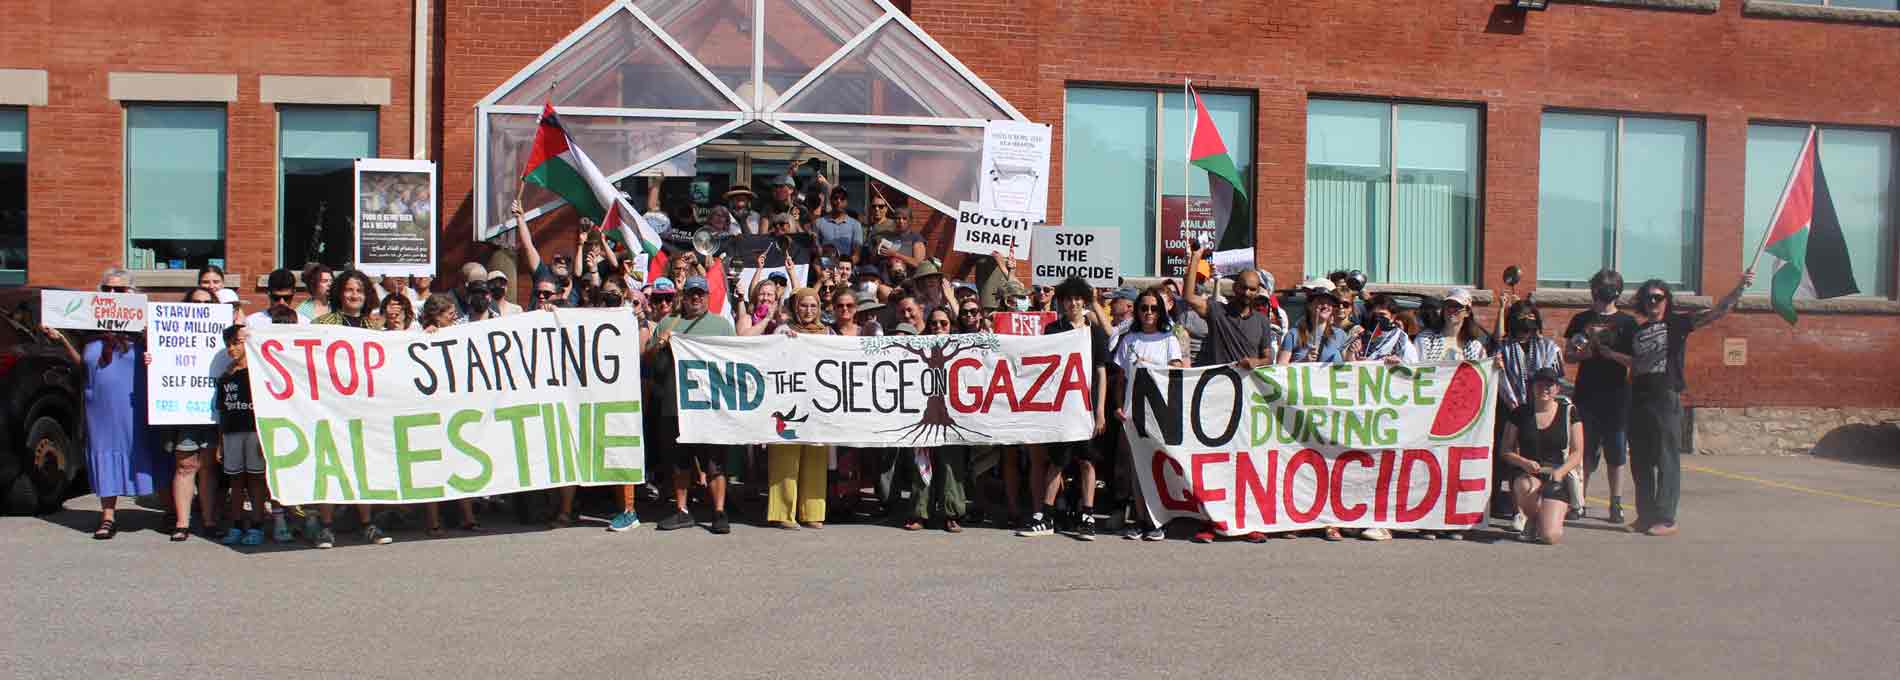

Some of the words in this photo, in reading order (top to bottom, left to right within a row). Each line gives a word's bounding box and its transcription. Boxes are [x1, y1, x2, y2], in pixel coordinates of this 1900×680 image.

[966, 230, 1019, 247] ISRAEL
[1055, 233, 1095, 246] STOP
[1058, 249, 1088, 262] THE
[1036, 264, 1114, 280] GENOCIDE
[95, 306, 143, 321] EMBARGO
[156, 304, 211, 319] STARVING
[154, 319, 180, 333] TWO
[184, 320, 226, 334] MILLION
[159, 335, 198, 348] PEOPLE
[205, 336, 217, 349] IS
[175, 354, 197, 367] NOT
[260, 338, 386, 400] STOP
[407, 323, 622, 396] STARVING
[162, 375, 186, 388] SELF
[678, 359, 766, 411] END
[767, 370, 807, 395] THE
[812, 358, 921, 414] SIEGE
[920, 369, 948, 397] ON
[948, 352, 1093, 414] GAZA
[1131, 365, 1243, 447] NO
[1251, 363, 1437, 406] SILENCE
[1249, 406, 1399, 448] DURING
[256, 400, 642, 501] PALESTINE
[1151, 446, 1489, 531] GENOCIDE
